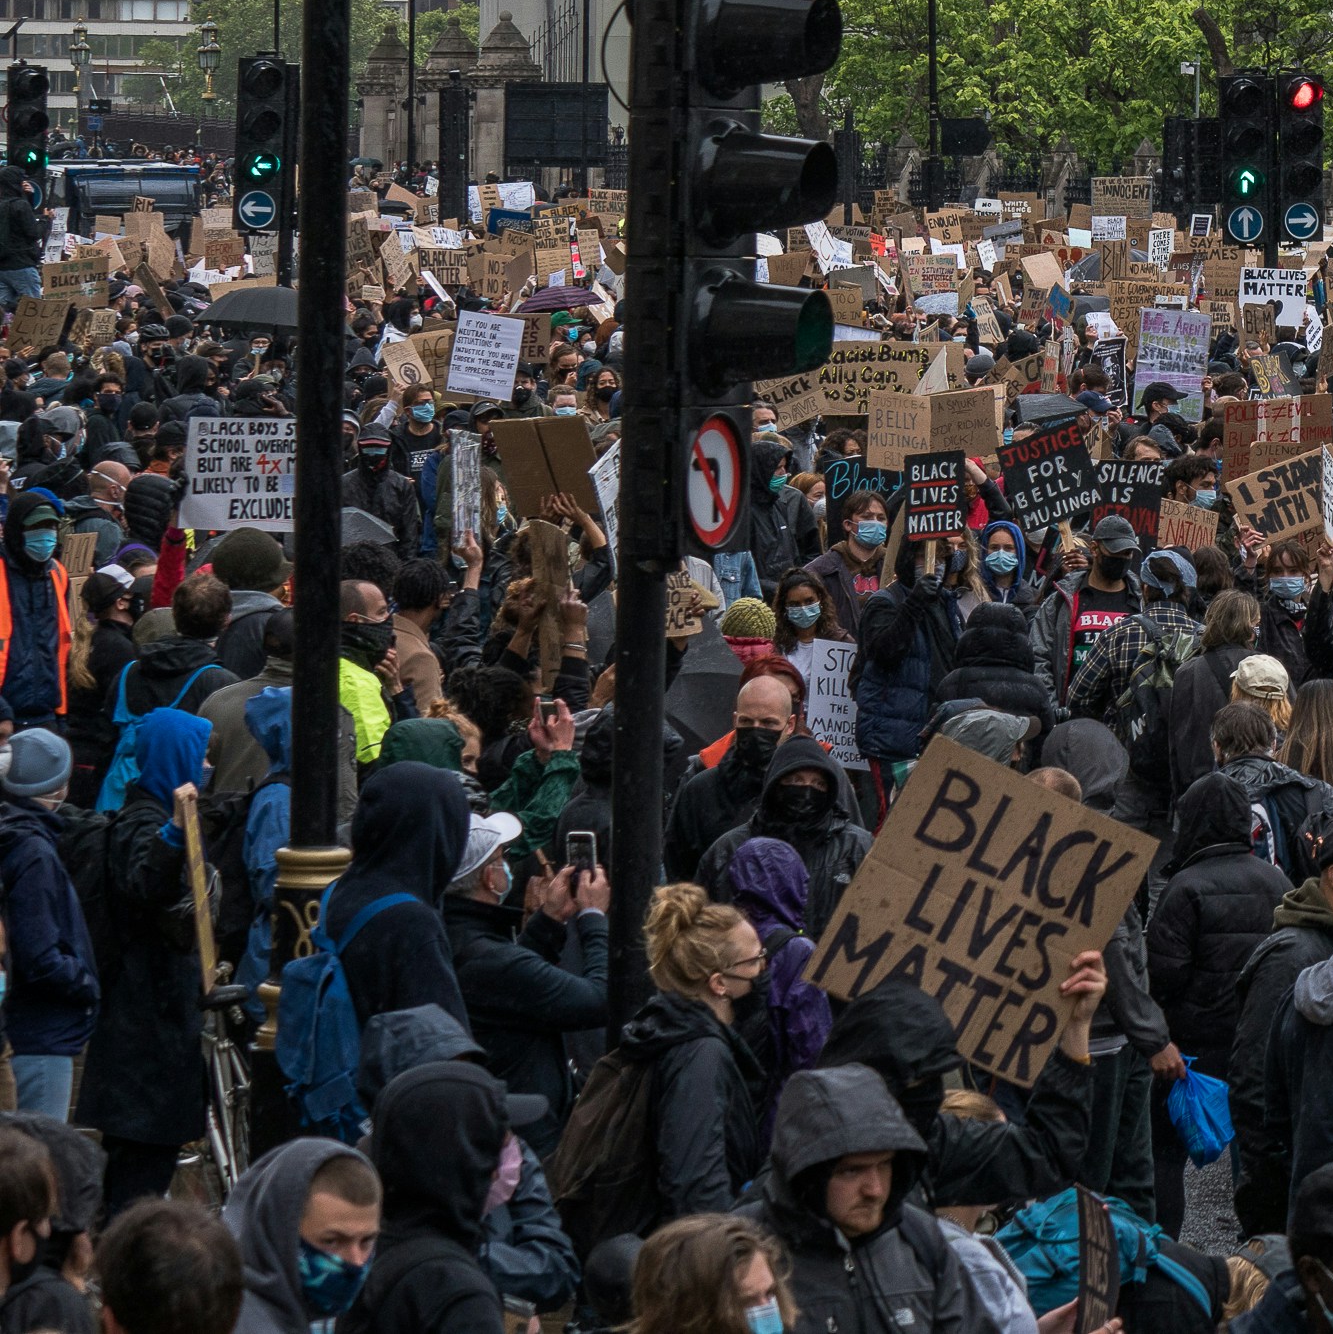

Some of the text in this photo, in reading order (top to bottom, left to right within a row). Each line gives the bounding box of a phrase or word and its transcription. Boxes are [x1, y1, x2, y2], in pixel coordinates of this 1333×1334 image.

[591, 190, 608, 199] BLACK
[928, 215, 959, 229] ENOUGH
[846, 227, 869, 237] VOTING
[1152, 232, 1170, 240] THERE
[1190, 237, 1213, 248] SAY
[420, 249, 468, 267] BLACK LIVES
[1172, 262, 1190, 270] LIVES
[51, 272, 108, 288] BLACK LIVES
[1244, 269, 1275, 280] BLACK
[1279, 270, 1307, 281] LIVES
[1113, 282, 1125, 295] THE
[1243, 283, 1307, 297] MATTER!
[475, 320, 487, 329] YOU
[459, 328, 486, 339] NEUTRAL
[457, 337, 492, 348] SITUATIONS
[454, 355, 505, 369] CHOSEN THE SIDE
[455, 347, 515, 361] INJUSTICE YOU HAVE
[452, 364, 495, 376] THE OPPRESSOR
[875, 409, 918, 431] BELLY
[198, 421, 245, 436] BLACK
[248, 422, 278, 436] BOYS
[197, 438, 250, 454] SCHOOL
[870, 433, 928, 450] MUJINGA
[1001, 424, 1082, 468] JUSTICE
[197, 456, 252, 473] BUT ARE
[911, 461, 957, 481] BLACK
[1027, 456, 1069, 484] FOR
[1097, 462, 1166, 486] SILENCE
[192, 475, 278, 494] LIKELY TO BE
[1015, 470, 1083, 510] BELLY
[910, 485, 958, 505] LIVES
[1111, 487, 1134, 504] IS
[1022, 488, 1102, 531] MUJINGA
[1245, 492, 1310, 538] WITH
[908, 509, 963, 534] MATTER
[830, 703, 848, 714] THE
[914, 767, 1136, 928] BLACK
[903, 862, 1068, 992] LIVES
